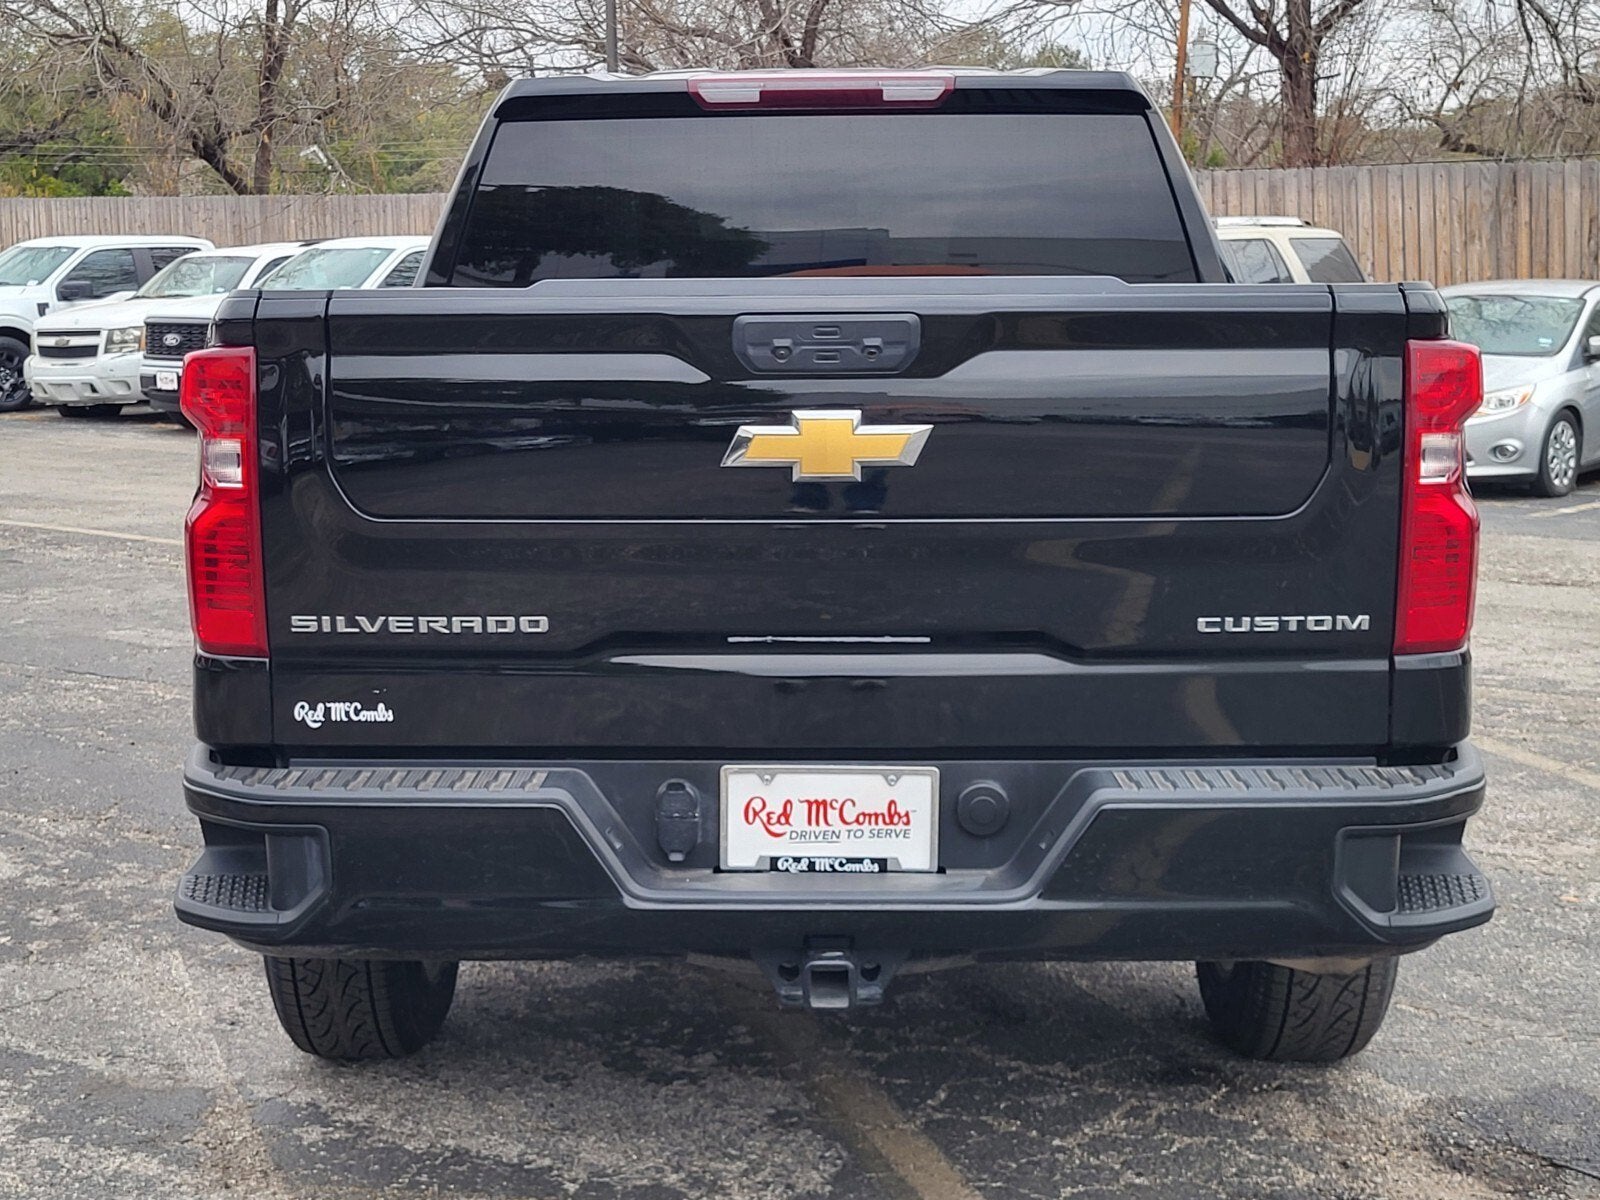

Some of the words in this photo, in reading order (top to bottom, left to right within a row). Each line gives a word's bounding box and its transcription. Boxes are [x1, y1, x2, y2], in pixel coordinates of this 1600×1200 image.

[290, 615, 549, 634] SILVERADO
[1197, 615, 1370, 633] CUSTOM
[294, 701, 325, 729] Red
[325, 701, 394, 722] McCombs
[744, 796, 793, 837] Red
[798, 799, 911, 827] McCombs
[789, 829, 841, 841] DRIVEN
[846, 829, 864, 840] TO
[868, 828, 911, 839] SERVE
[777, 857, 810, 873] Red
[810, 857, 880, 873] McCombs
